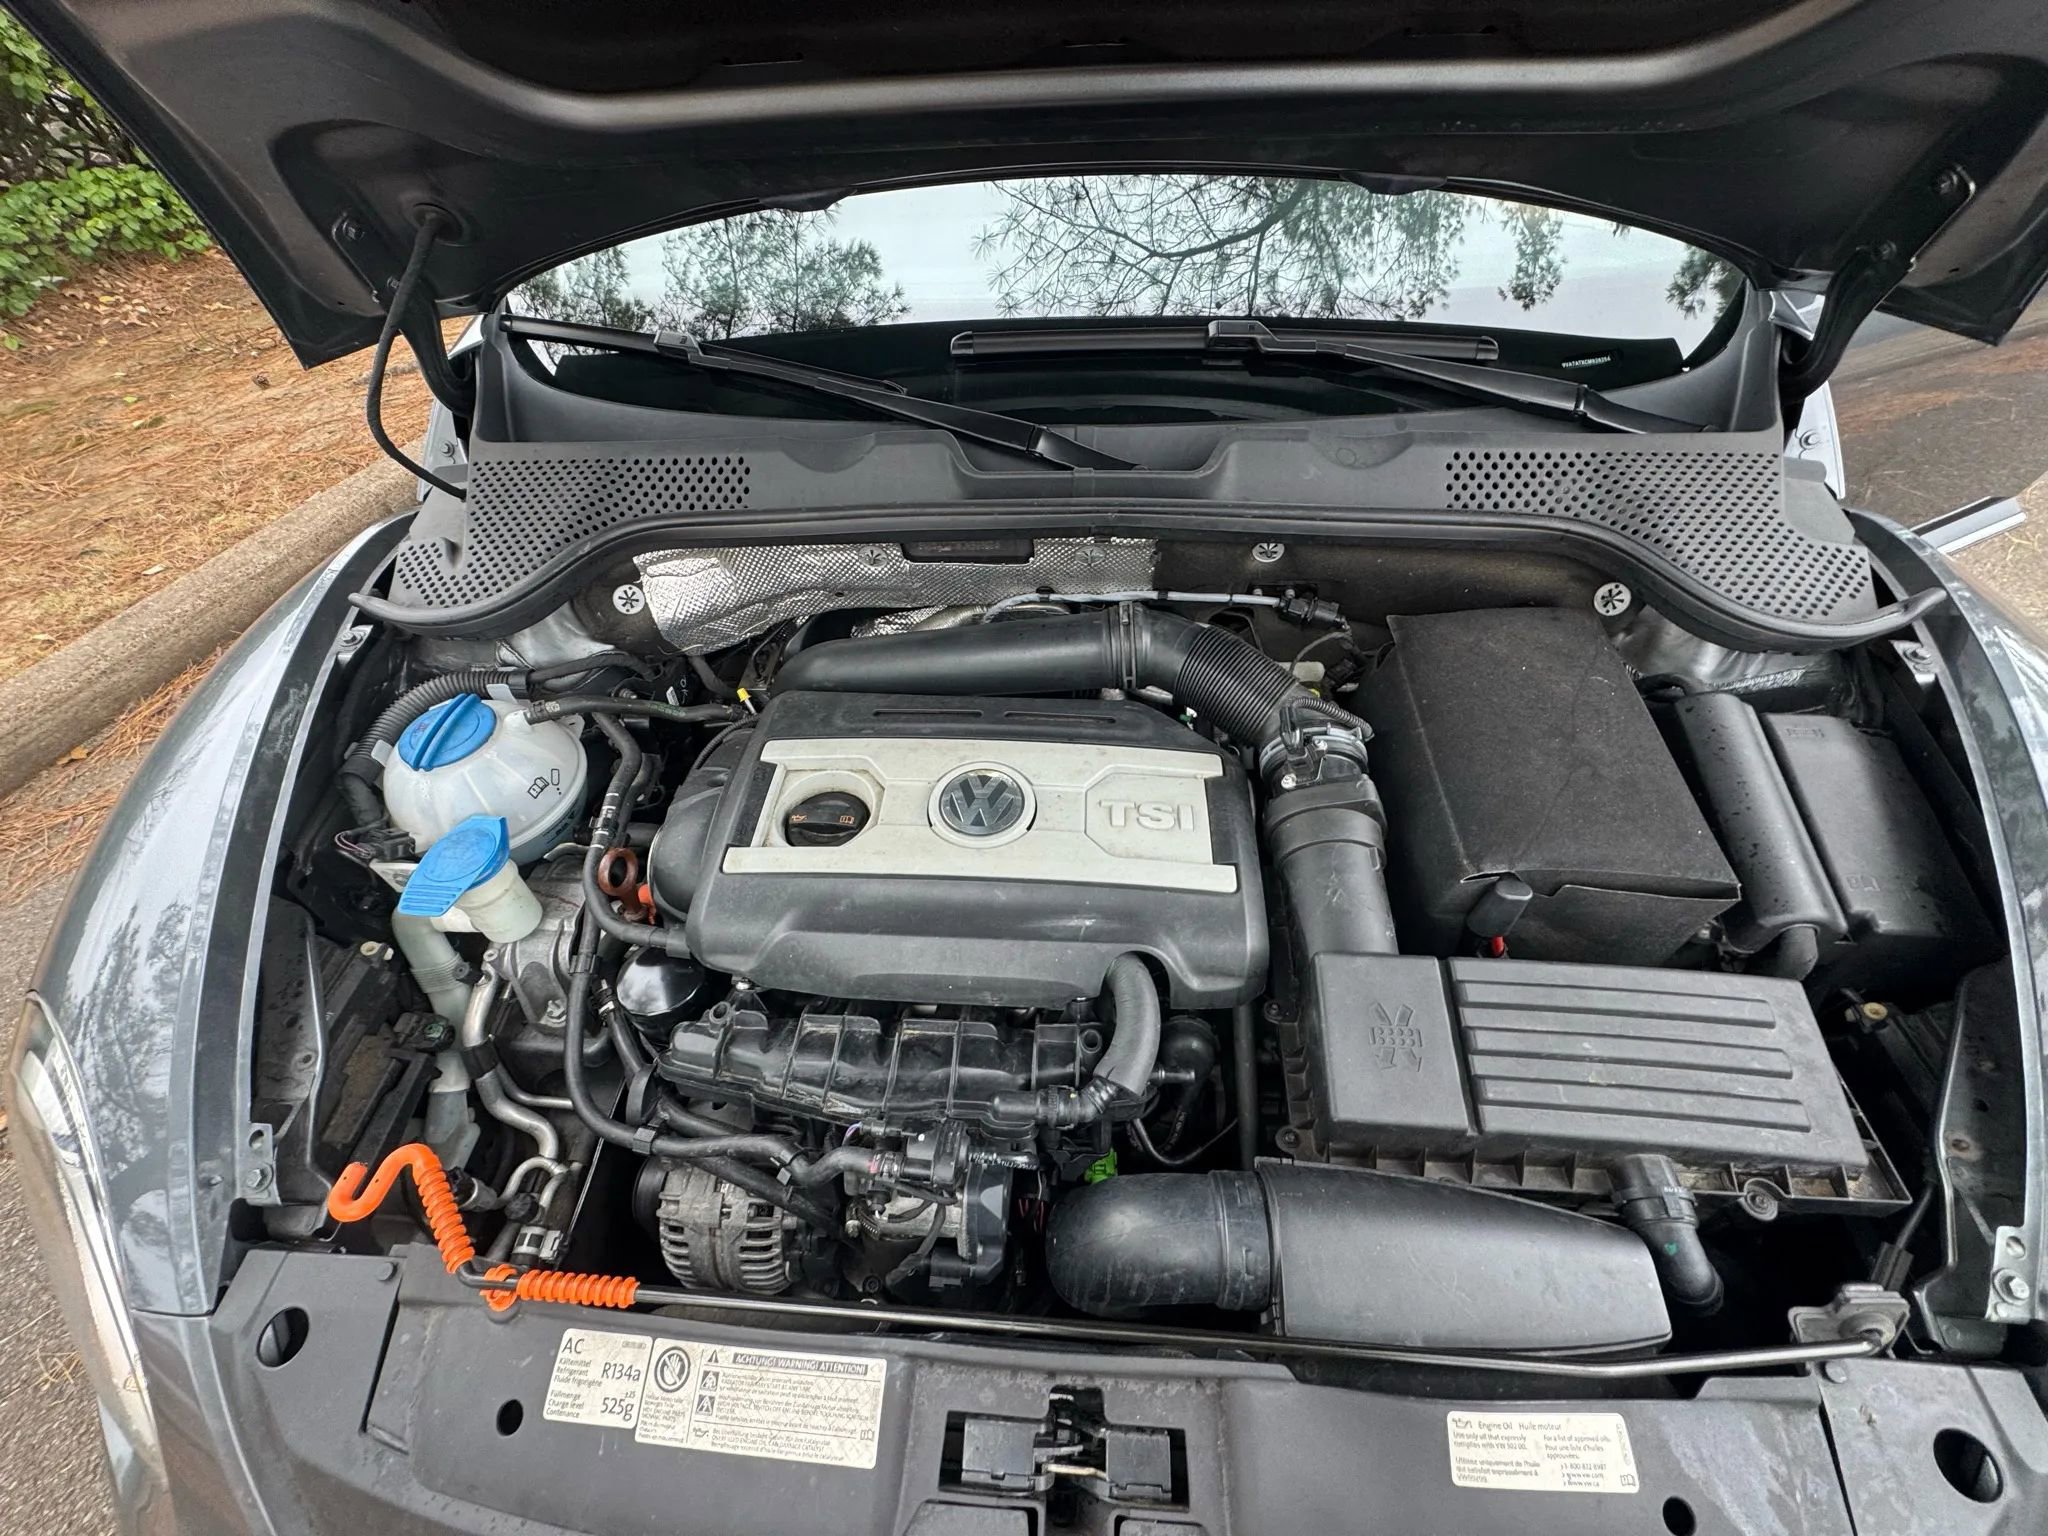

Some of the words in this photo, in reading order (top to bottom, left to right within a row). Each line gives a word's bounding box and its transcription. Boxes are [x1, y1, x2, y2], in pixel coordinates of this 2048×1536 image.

[1099, 798, 1196, 833] TSI
[561, 1337, 585, 1354] AC
[601, 1361, 642, 1382] R134a
[735, 1354, 776, 1368] ACHTUNG!
[777, 1358, 819, 1371] WARNING!
[819, 1361, 865, 1375] ATTENTION!
[546, 1407, 580, 1418] Contenance
[548, 1399, 569, 1409] Charge
[600, 1397, 634, 1422] 525g
[1478, 1420, 1502, 1431] Engine
[1502, 1422, 1513, 1430] Oil
[1519, 1422, 1536, 1431] Huile
[1537, 1423, 1561, 1431] moteur
